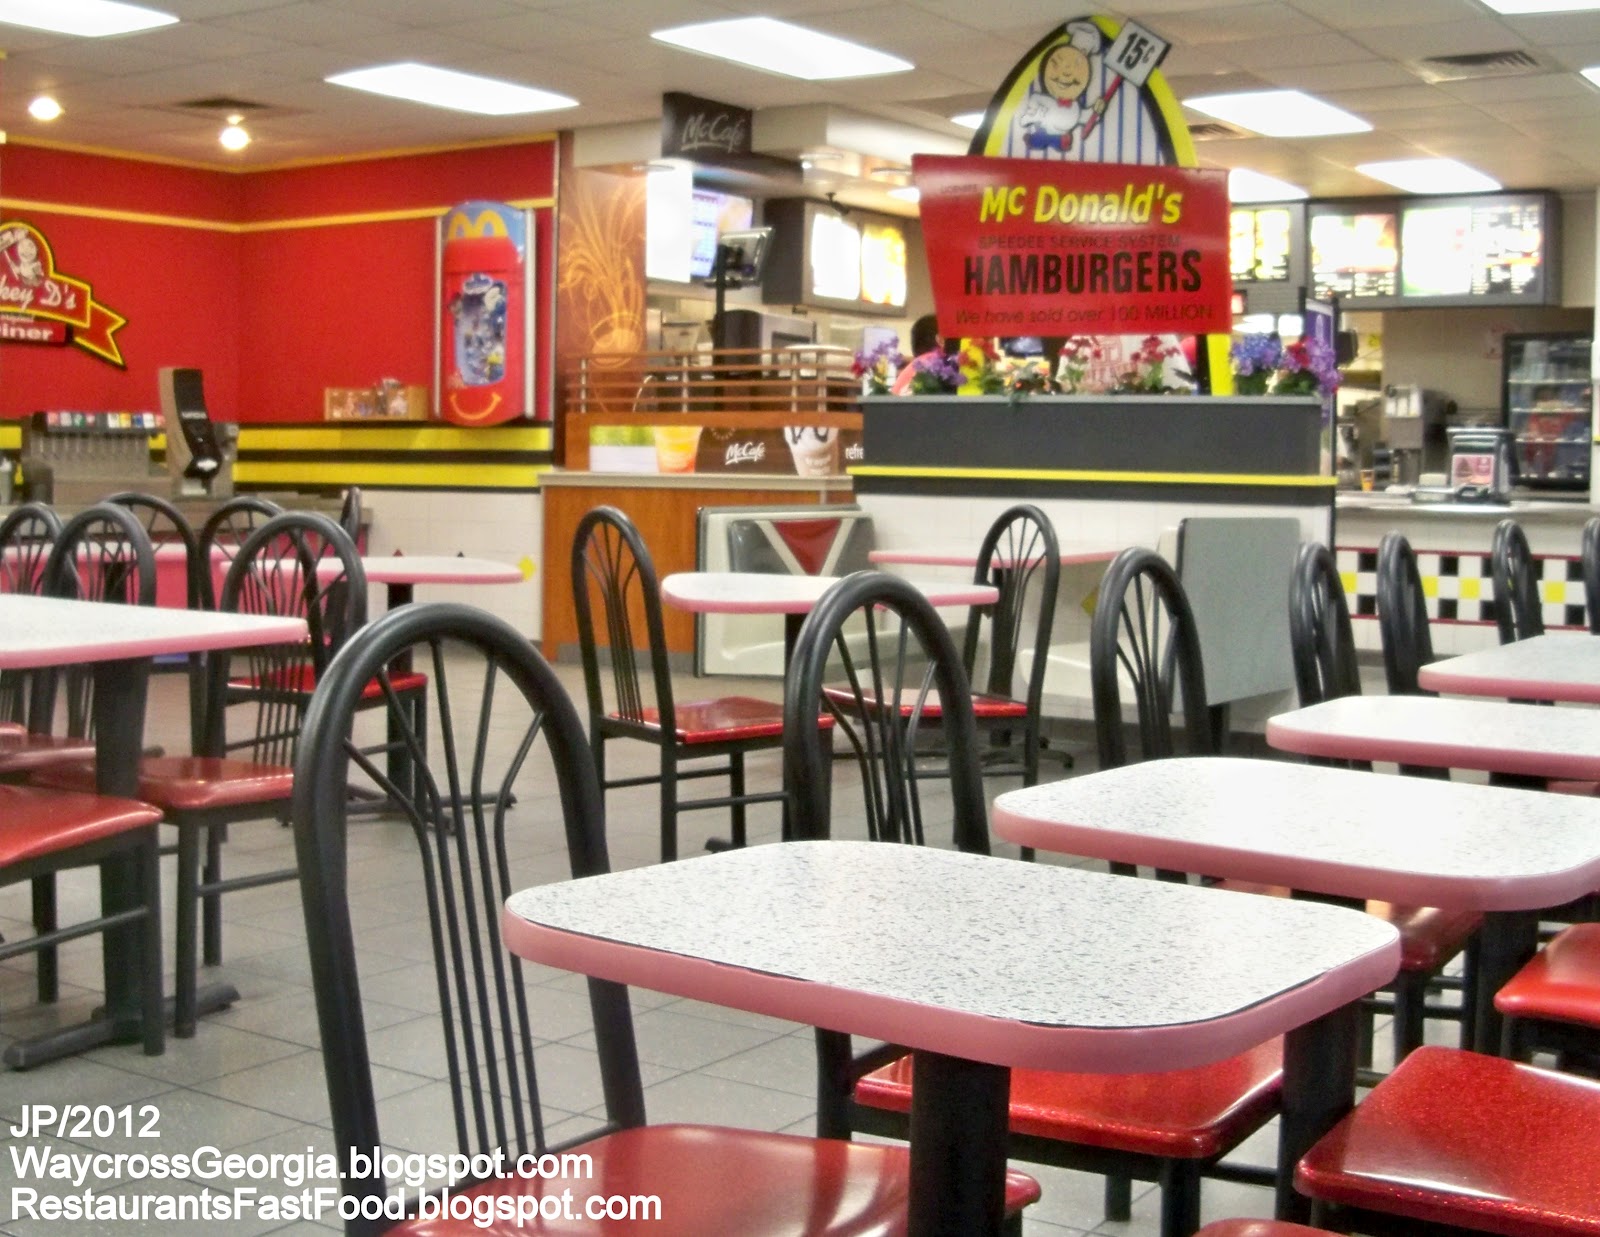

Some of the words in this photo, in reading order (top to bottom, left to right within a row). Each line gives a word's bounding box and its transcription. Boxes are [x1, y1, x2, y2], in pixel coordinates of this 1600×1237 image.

[1034, 184, 1183, 225] Donald's
[977, 236, 1044, 249] SPEEDEE
[1050, 235, 1113, 249] SERVICE
[1117, 233, 1182, 248] SYSTEM
[963, 249, 1203, 296] HAMBURGERS
[956, 309, 981, 325] We
[984, 309, 1025, 323] have
[1029, 307, 1063, 323] sold
[1068, 309, 1103, 322] over
[1110, 305, 1140, 321] 100
[1144, 303, 1213, 321] MILLION
